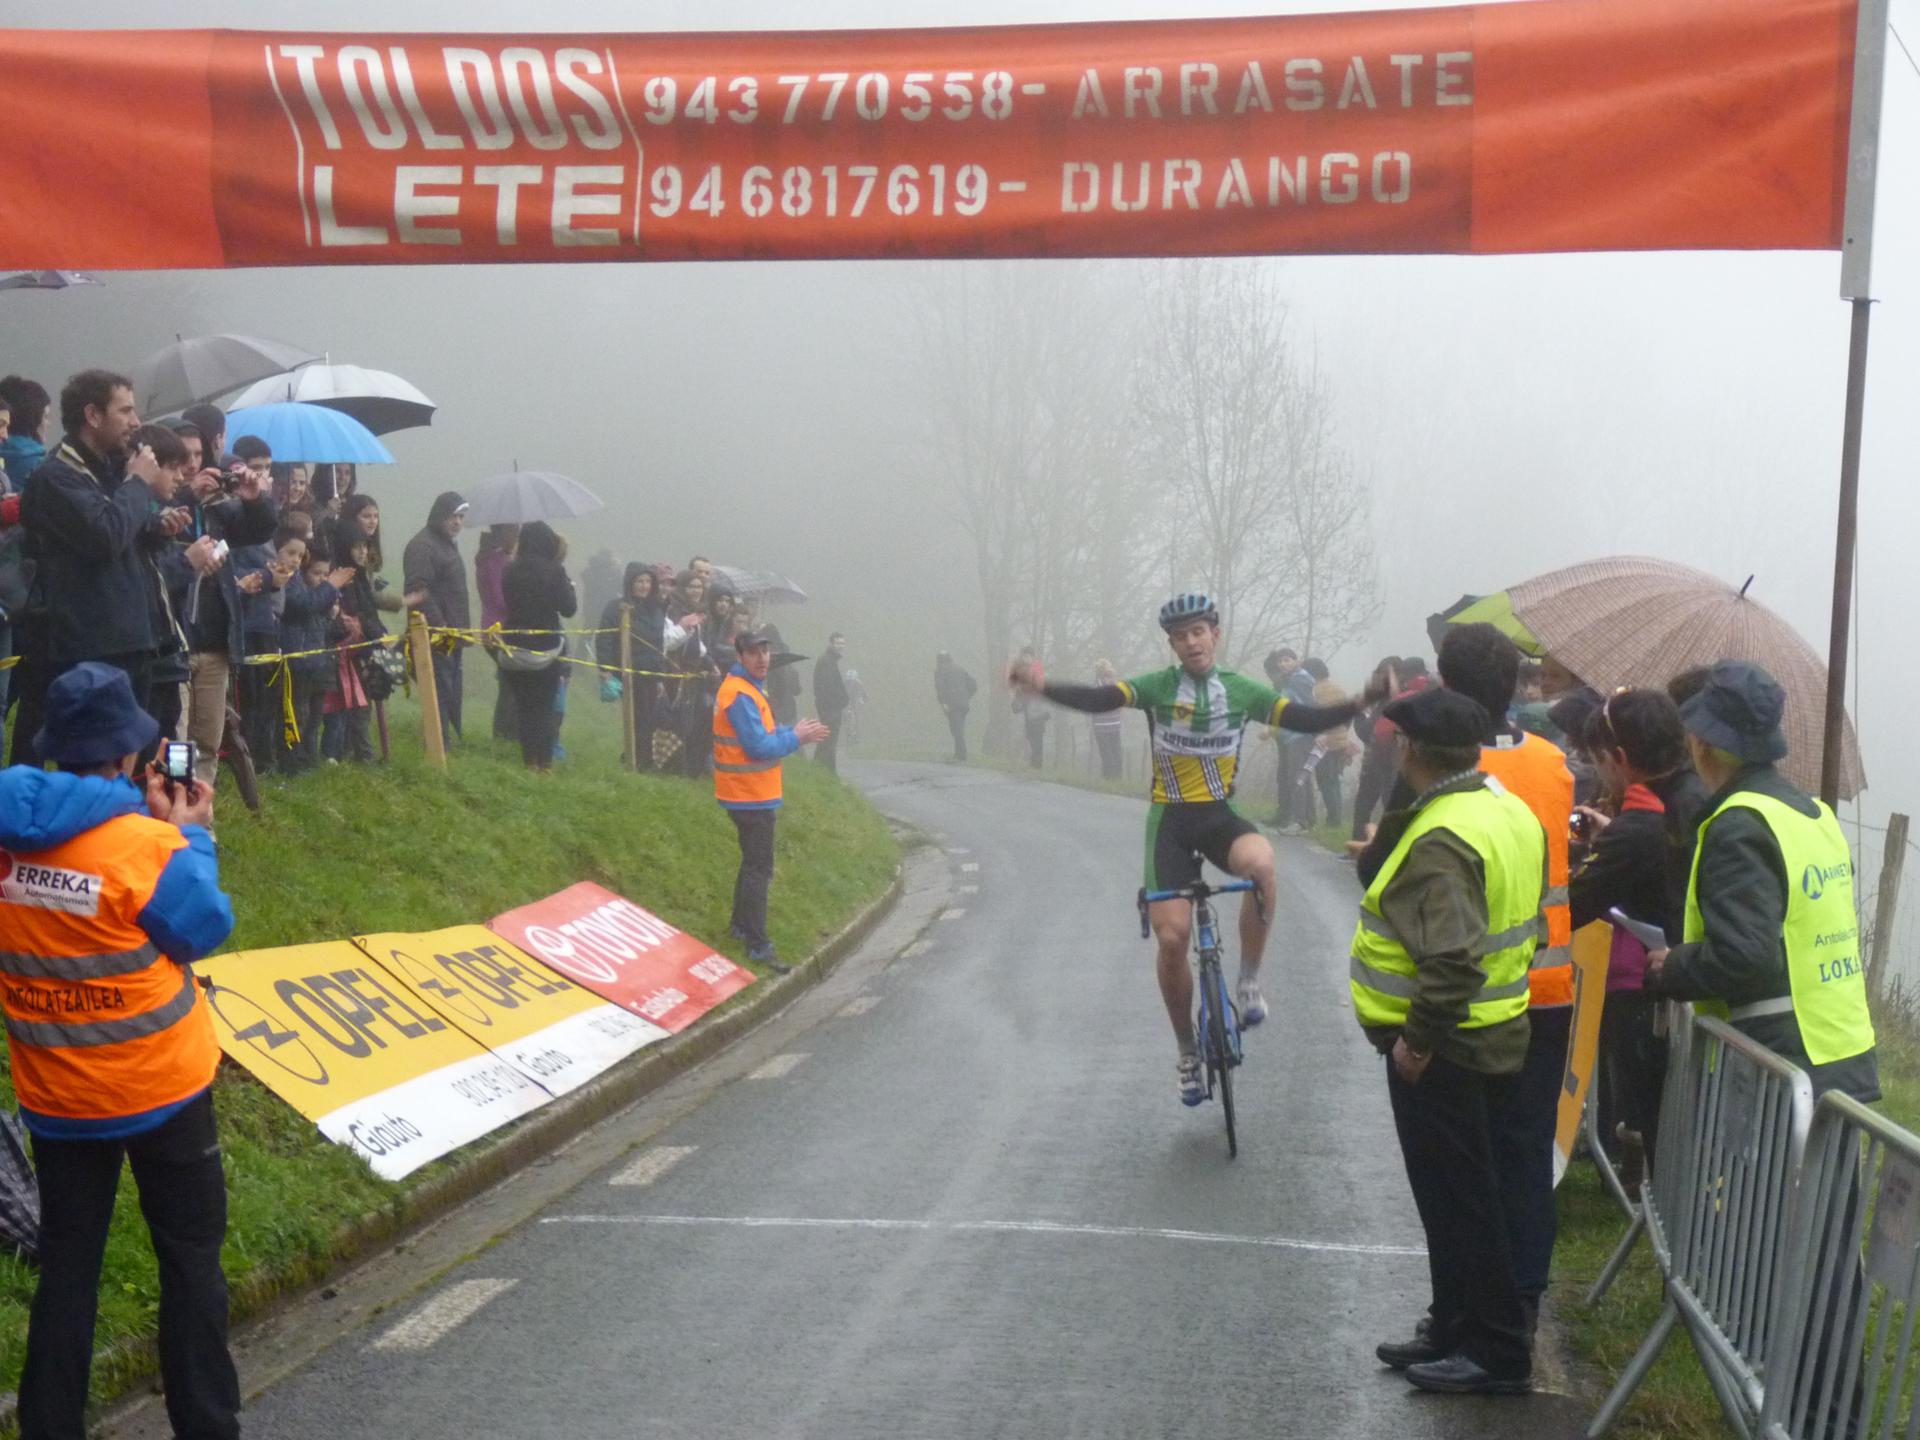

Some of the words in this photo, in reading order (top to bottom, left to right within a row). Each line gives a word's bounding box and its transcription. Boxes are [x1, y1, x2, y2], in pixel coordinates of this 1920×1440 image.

[279, 45, 624, 150] TOLDOS
[643, 74, 760, 125] 943
[1071, 51, 1474, 120] ARRASATE
[313, 164, 625, 247] LETE
[649, 164, 726, 218] 94
[1061, 151, 1413, 213] DURANGO
[15, 865, 90, 895] ERREKA
[558, 898, 681, 965] TOYOTA
[433, 944, 573, 1009] OPEL
[273, 967, 447, 1058] OPEL
[348, 1112, 423, 1157] Giauto
